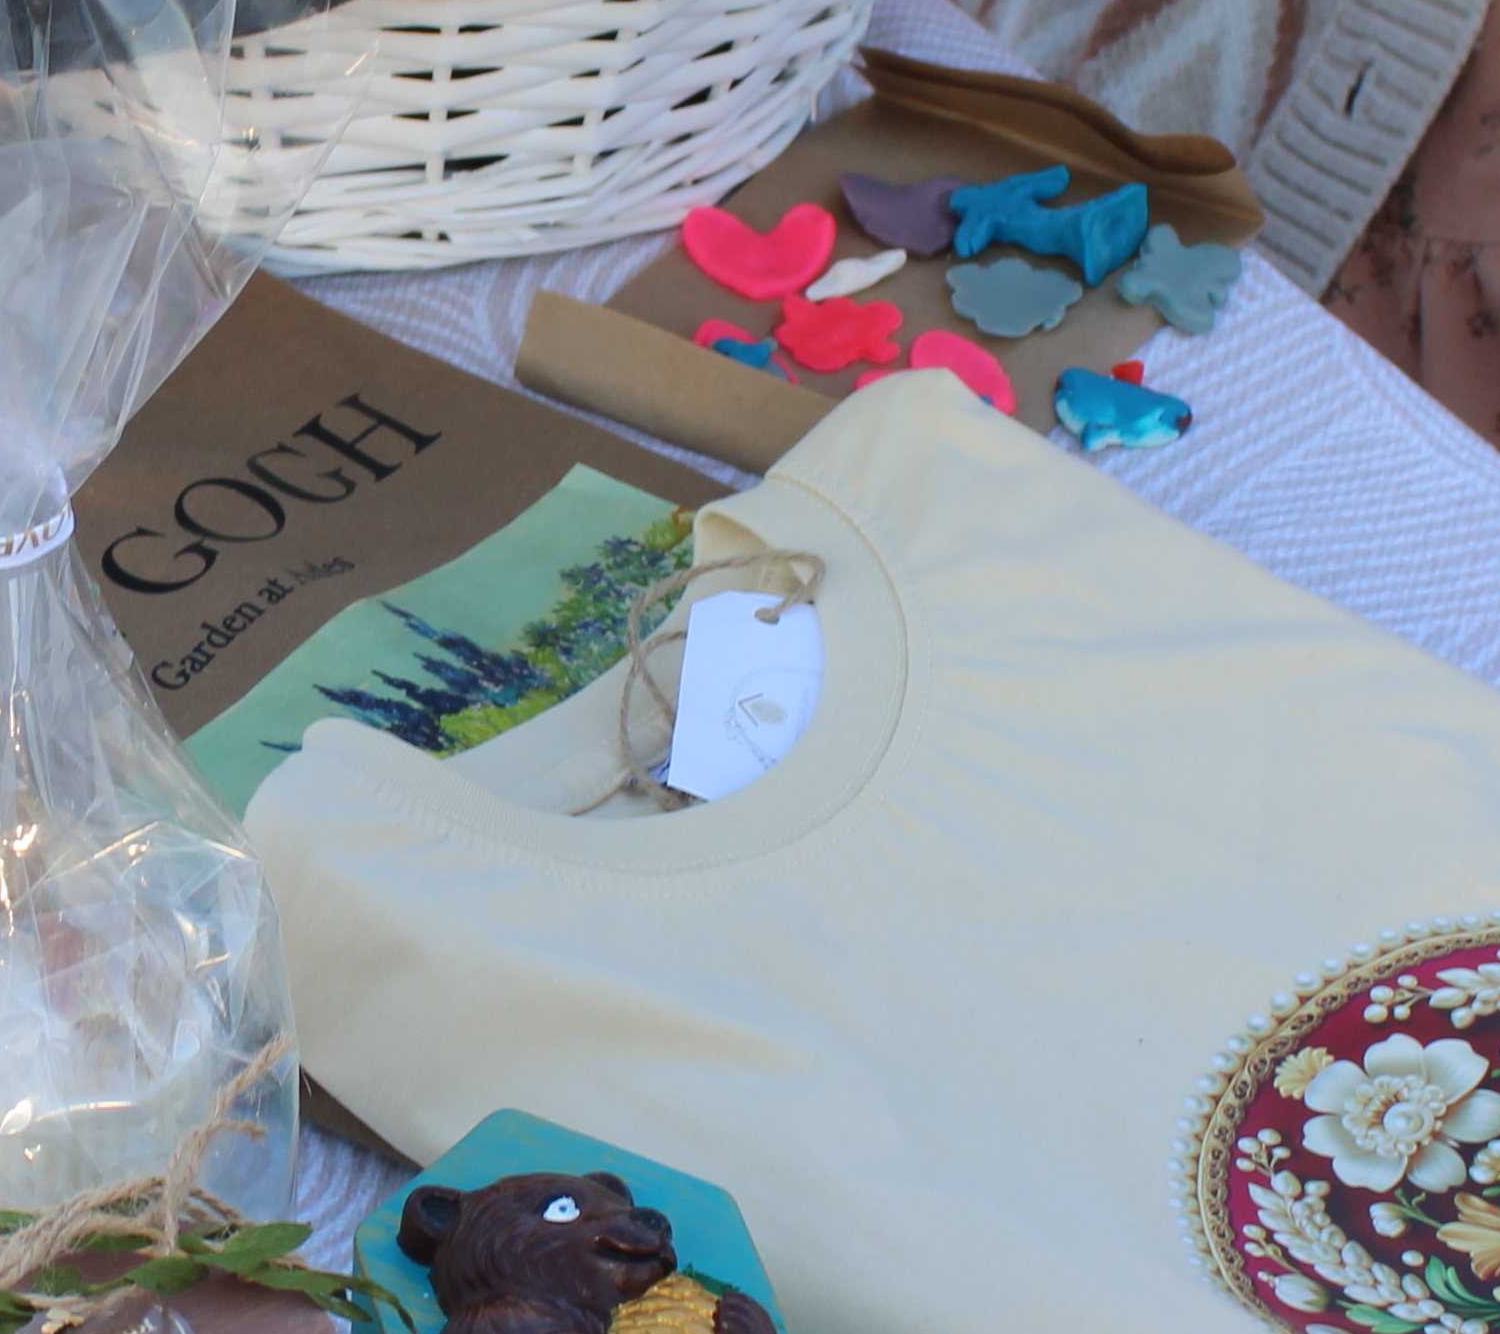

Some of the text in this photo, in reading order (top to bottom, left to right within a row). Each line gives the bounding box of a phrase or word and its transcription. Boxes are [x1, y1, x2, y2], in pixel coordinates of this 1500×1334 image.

[101, 393, 442, 595] GOGH
[151, 600, 266, 691] Garden
[258, 576, 294, 607] at
